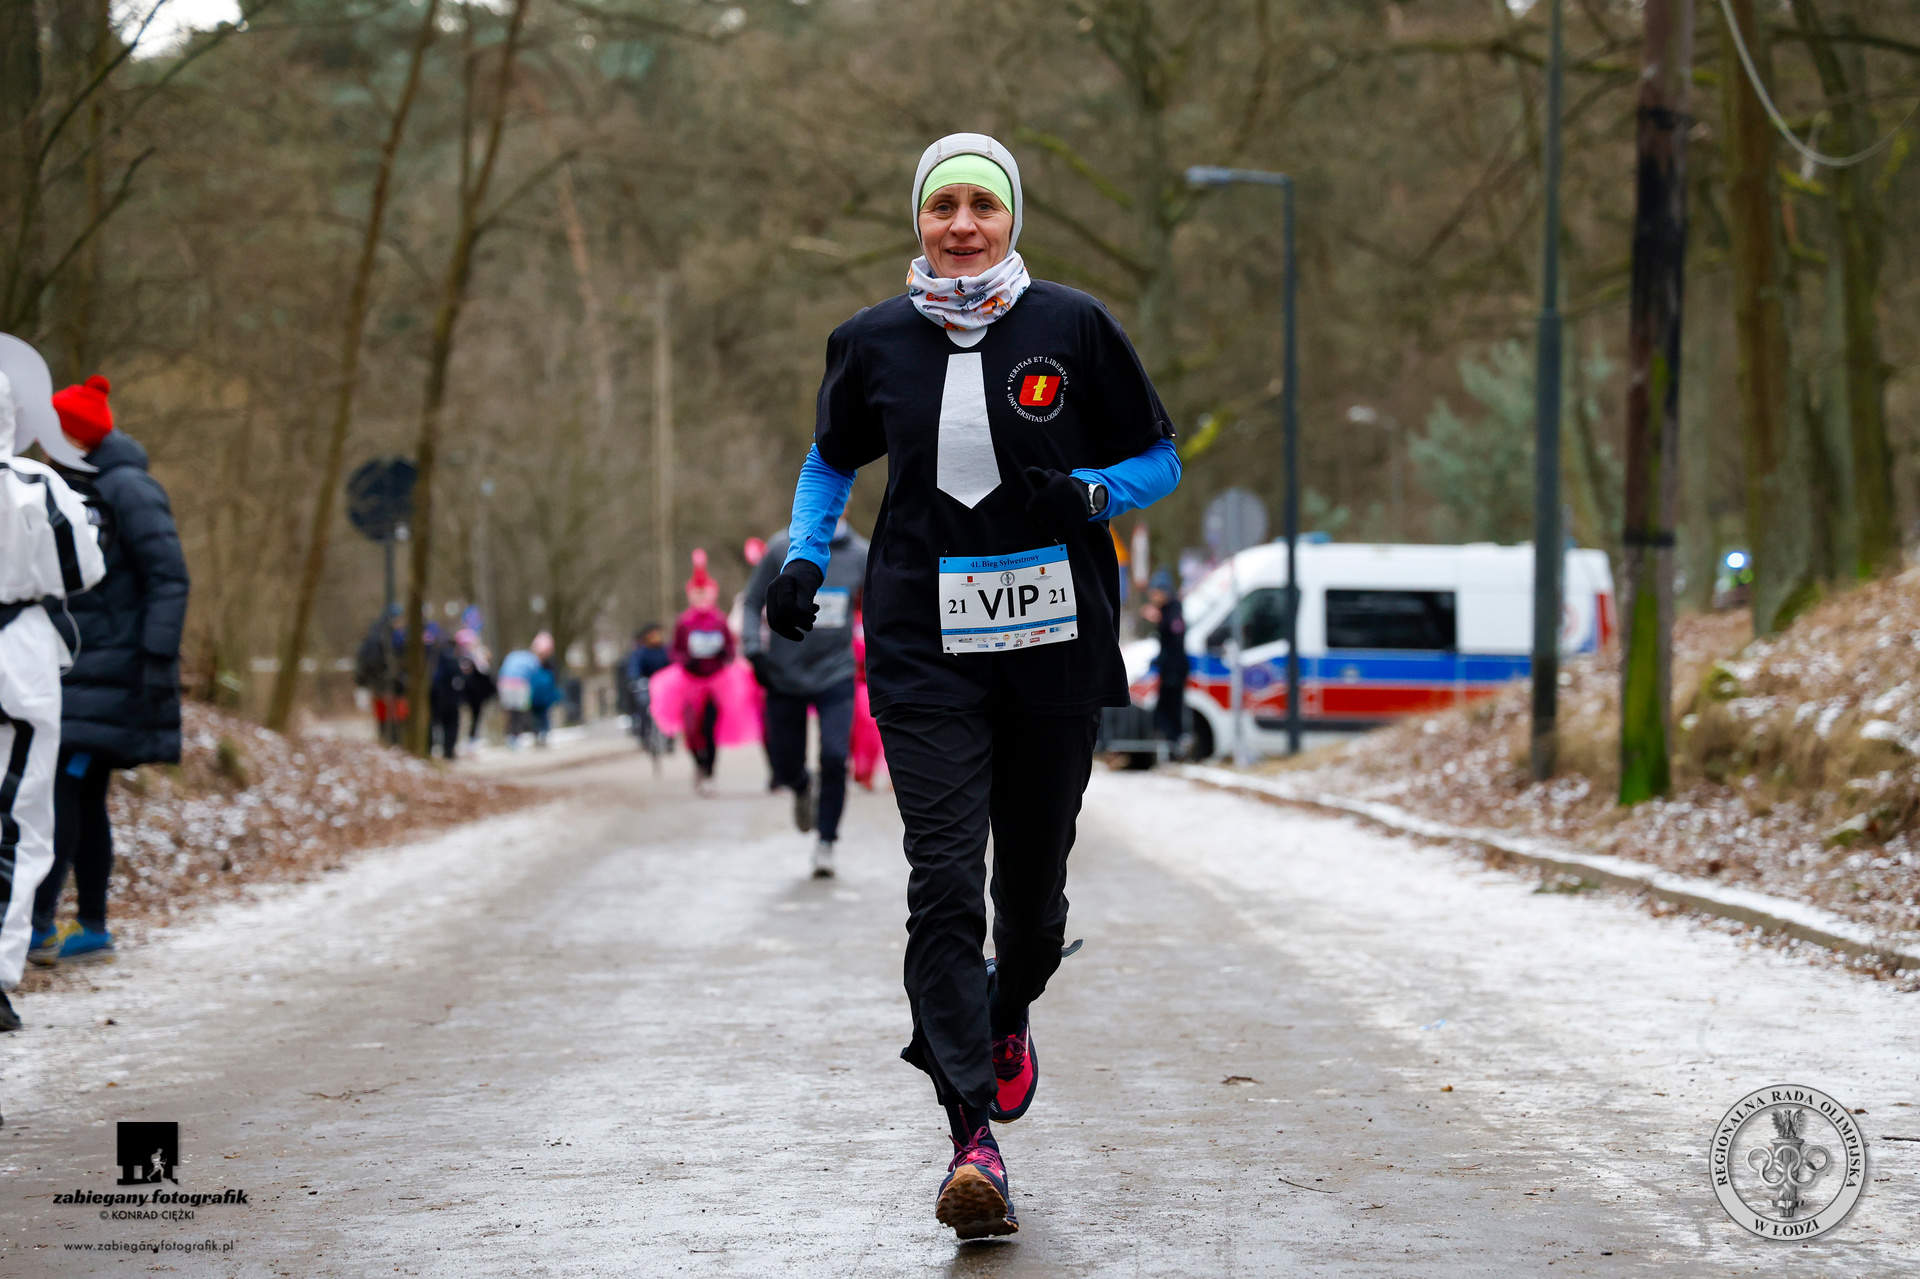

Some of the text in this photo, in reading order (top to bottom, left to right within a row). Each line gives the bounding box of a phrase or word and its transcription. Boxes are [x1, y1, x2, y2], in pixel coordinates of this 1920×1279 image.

[1007, 357, 1032, 383] VERITAS
[1045, 356, 1069, 385] LIBERTAS
[1007, 393, 1043, 423] UNIVERSITAS
[982, 560, 998, 569] Bieg
[999, 554, 1040, 568] Sylwestrowy
[947, 584, 1067, 621] 21 VIP 21
